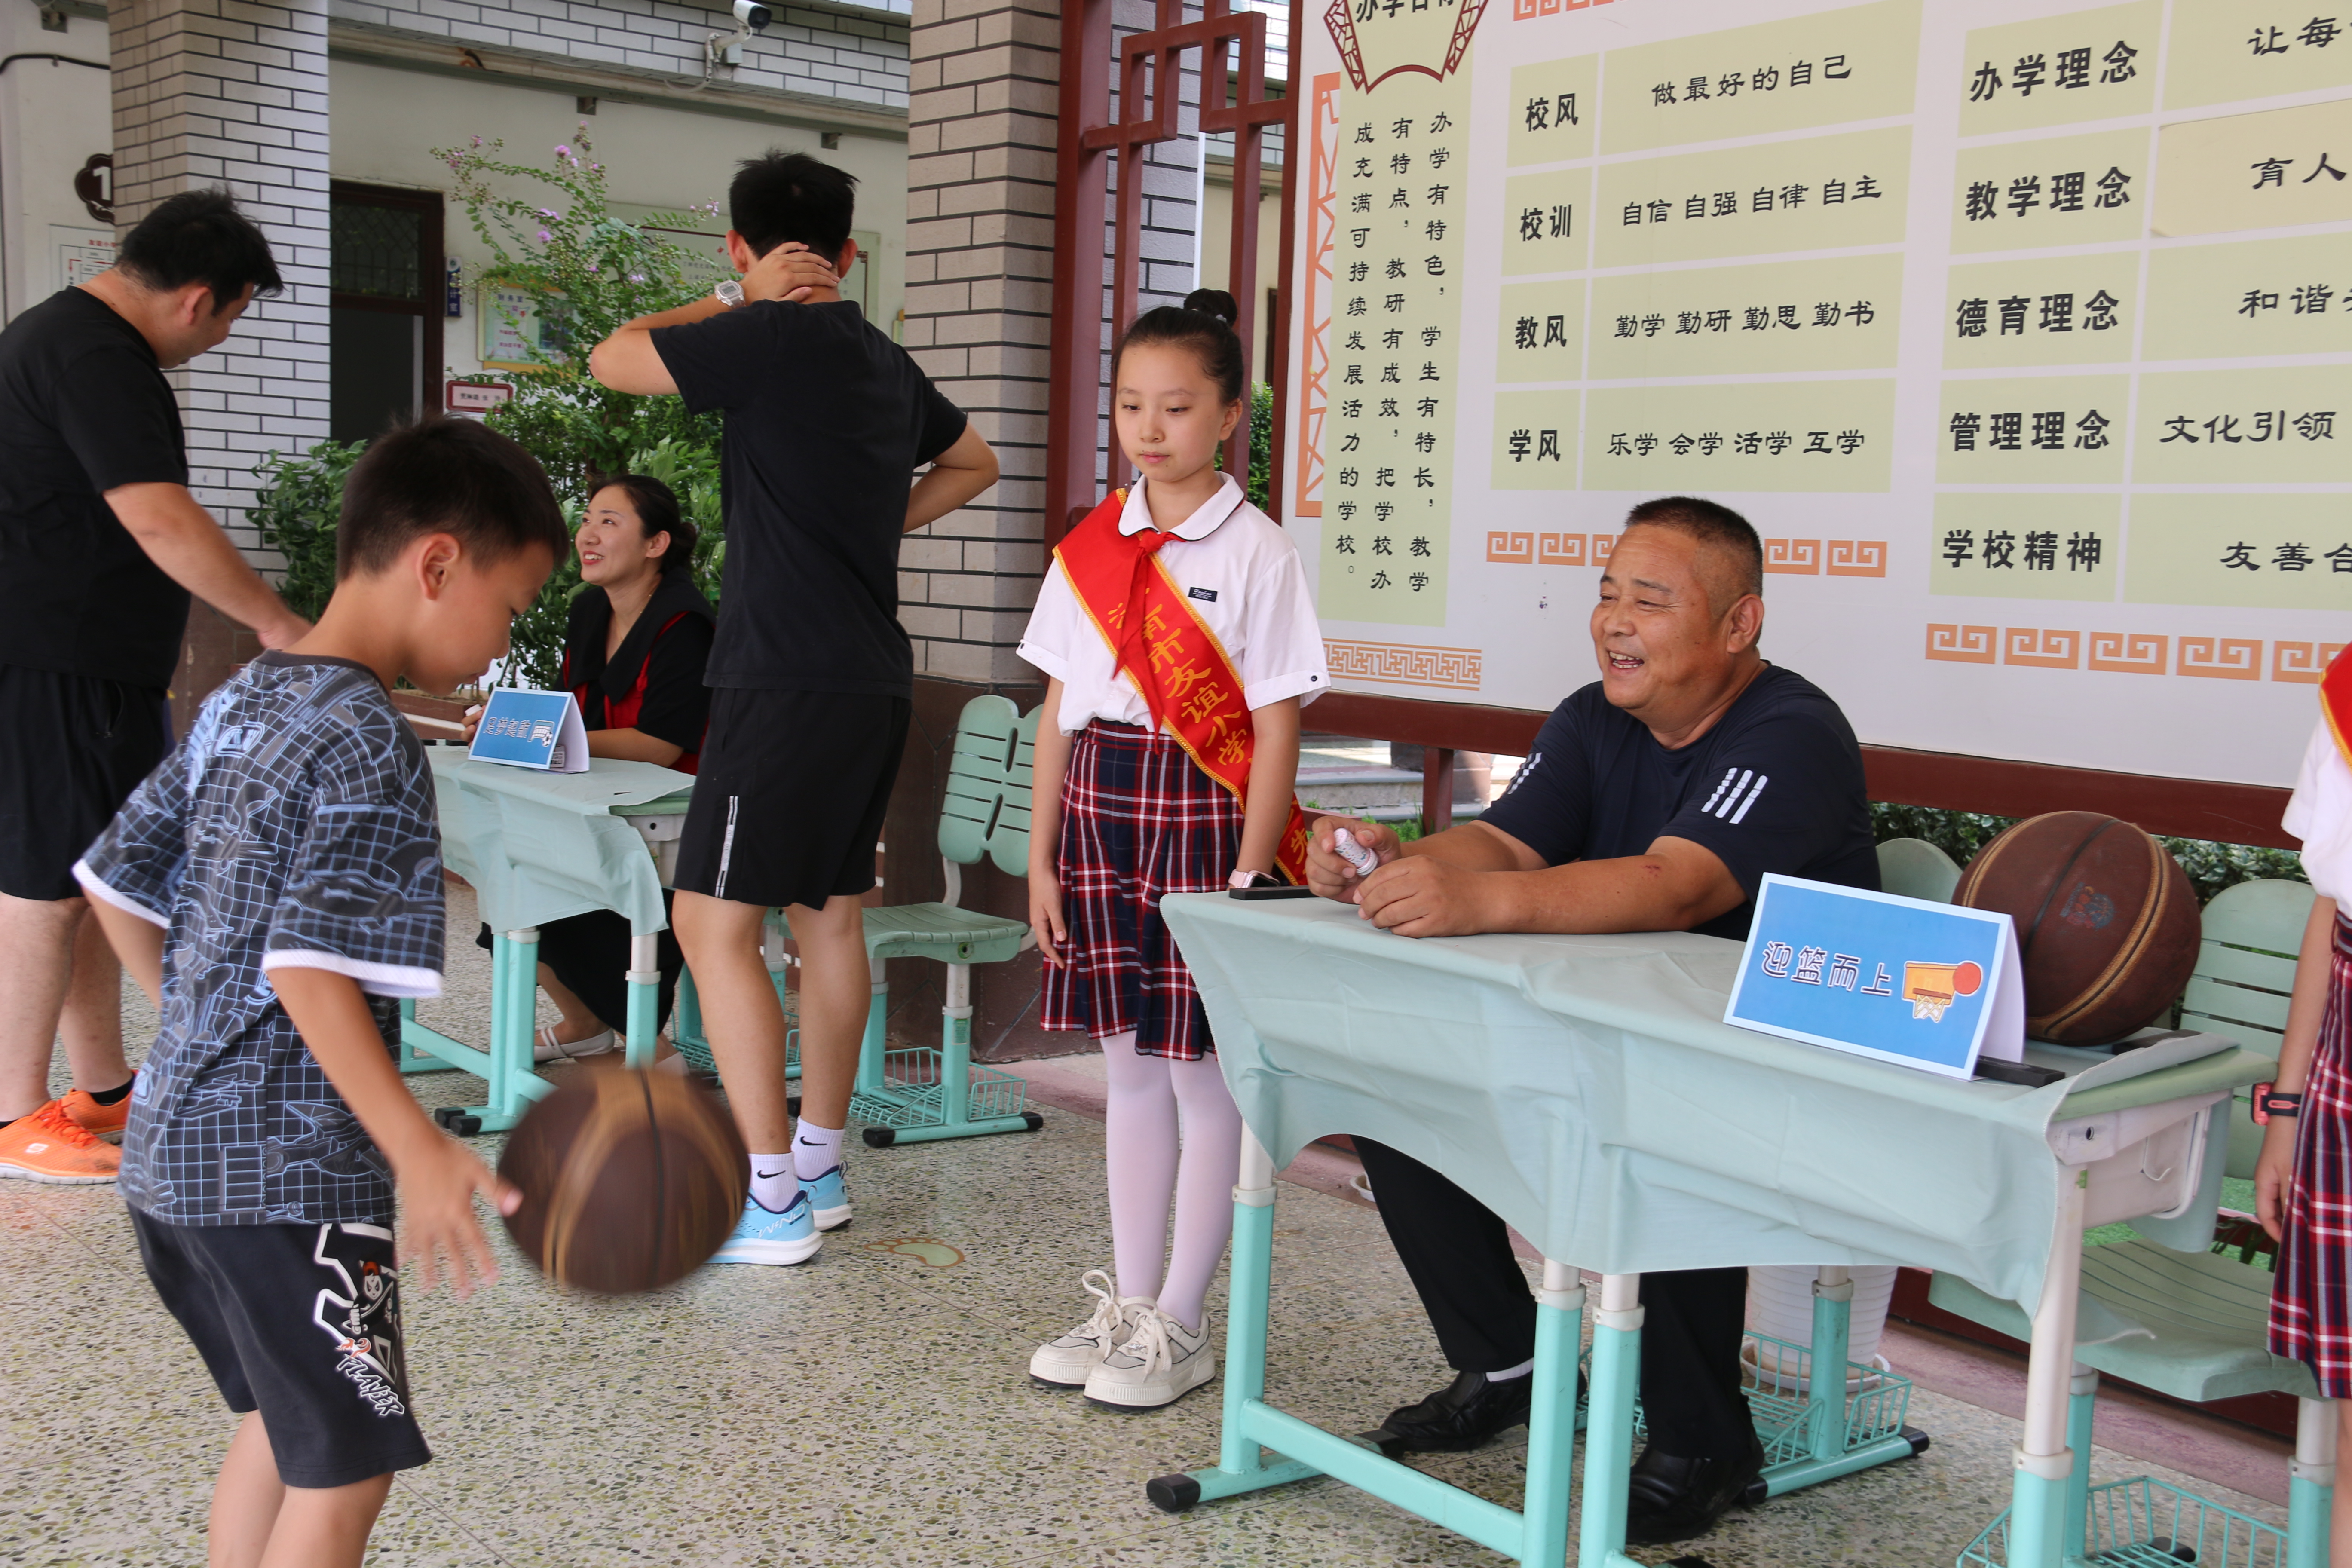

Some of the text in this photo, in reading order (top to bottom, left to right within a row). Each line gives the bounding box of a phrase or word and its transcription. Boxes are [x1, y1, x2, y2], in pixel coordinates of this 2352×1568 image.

[2247, 17, 2352, 56] 让每
[1651, 55, 1852, 107] 做最好的自己
[1970, 40, 2138, 102] 办学理念
[1525, 93, 1579, 132] 校风
[2251, 153, 2347, 190] 育人
[1623, 175, 1882, 226] 自信 自强 自律 自主
[1966, 166, 2132, 221] 教学理念
[1520, 204, 1572, 242] 校训
[1515, 315, 1567, 349] 教风
[1614, 300, 1874, 338] 勤学 勤研 勤思 勤书
[1955, 289, 2119, 338] 德育理念
[1509, 429, 1561, 462] 学风
[1607, 429, 1865, 456] 乐学 会学 活学 互学
[1950, 409, 2110, 452] 管理理念
[2159, 410, 2337, 443] 文化引领
[1942, 529, 2101, 572] 学校精神
[2220, 541, 2352, 573] 友善合
[1761, 941, 1892, 996] 迎篮而上
[337, 1354, 405, 1415] PLAYER
